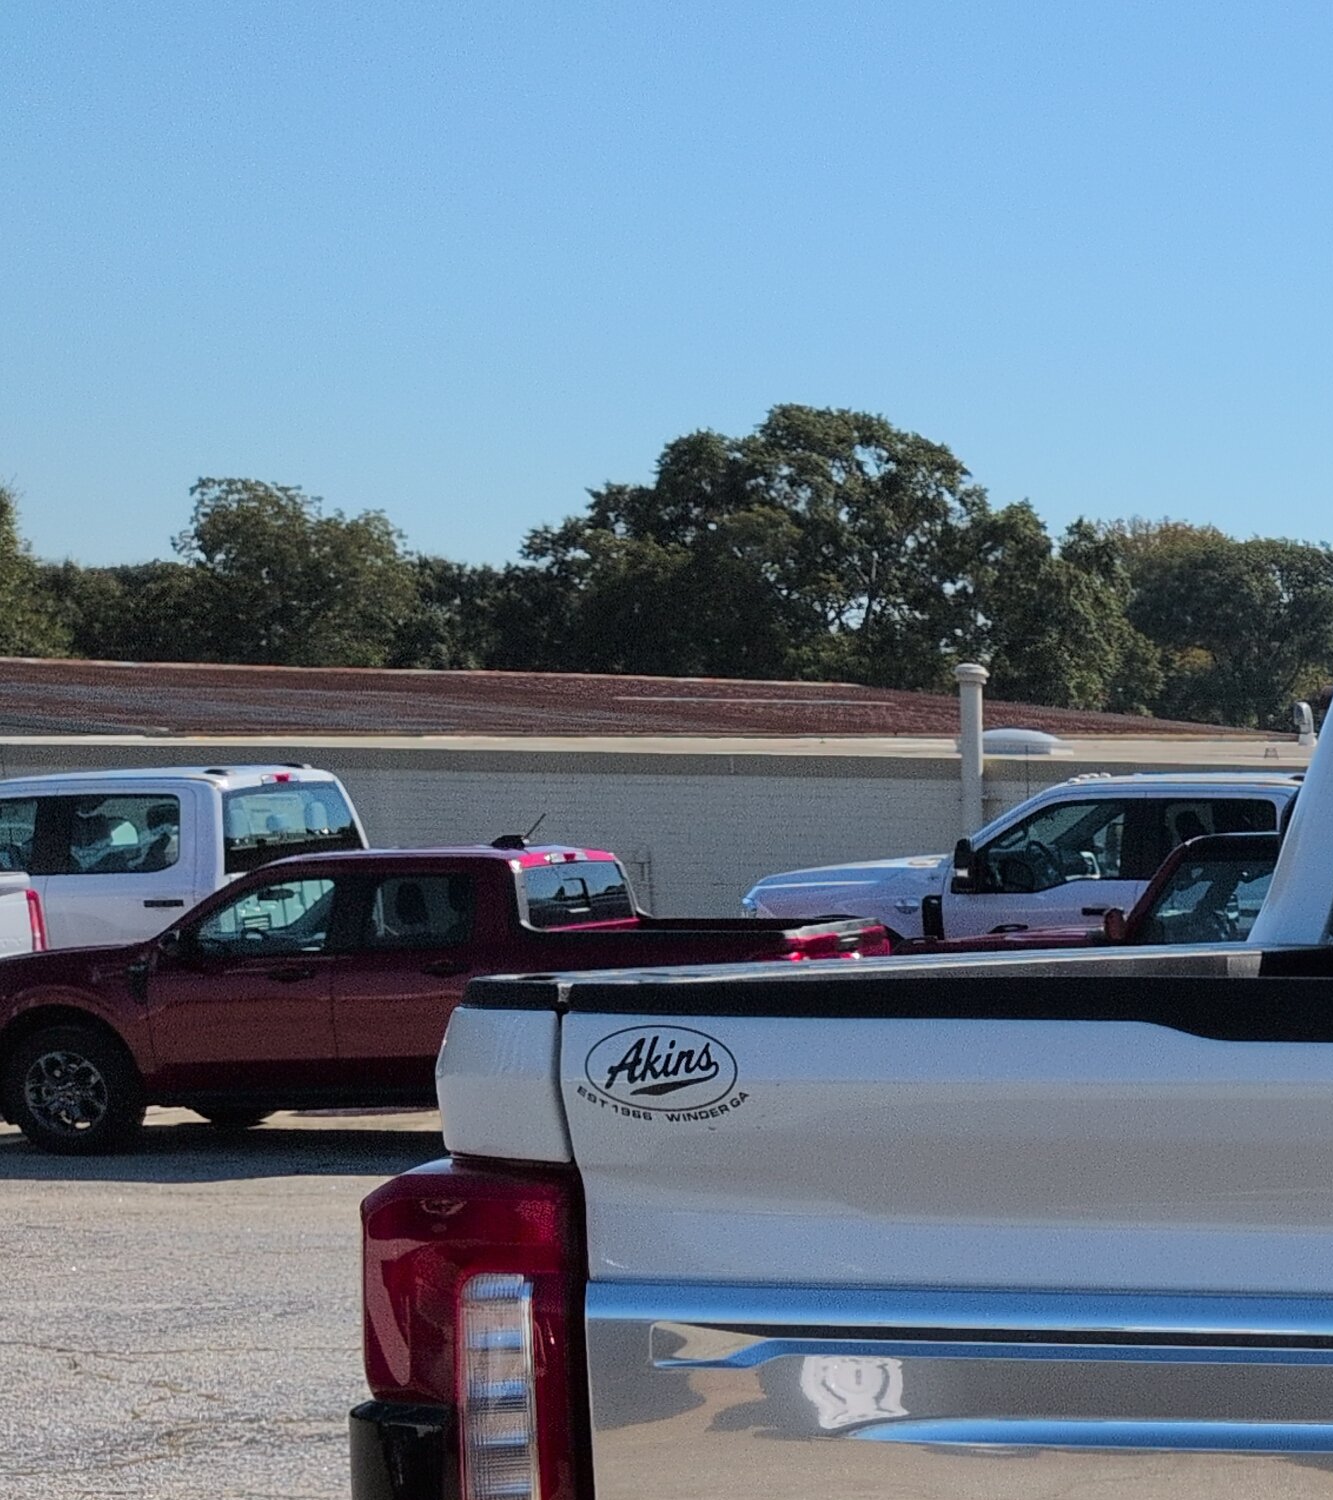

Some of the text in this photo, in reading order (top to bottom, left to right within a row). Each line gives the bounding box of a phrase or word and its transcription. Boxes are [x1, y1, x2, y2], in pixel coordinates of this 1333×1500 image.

[605, 1036, 719, 1095] Akins
[577, 1085, 608, 1109] EST
[666, 1103, 729, 1123] WINDER
[732, 1091, 750, 1108] GA
